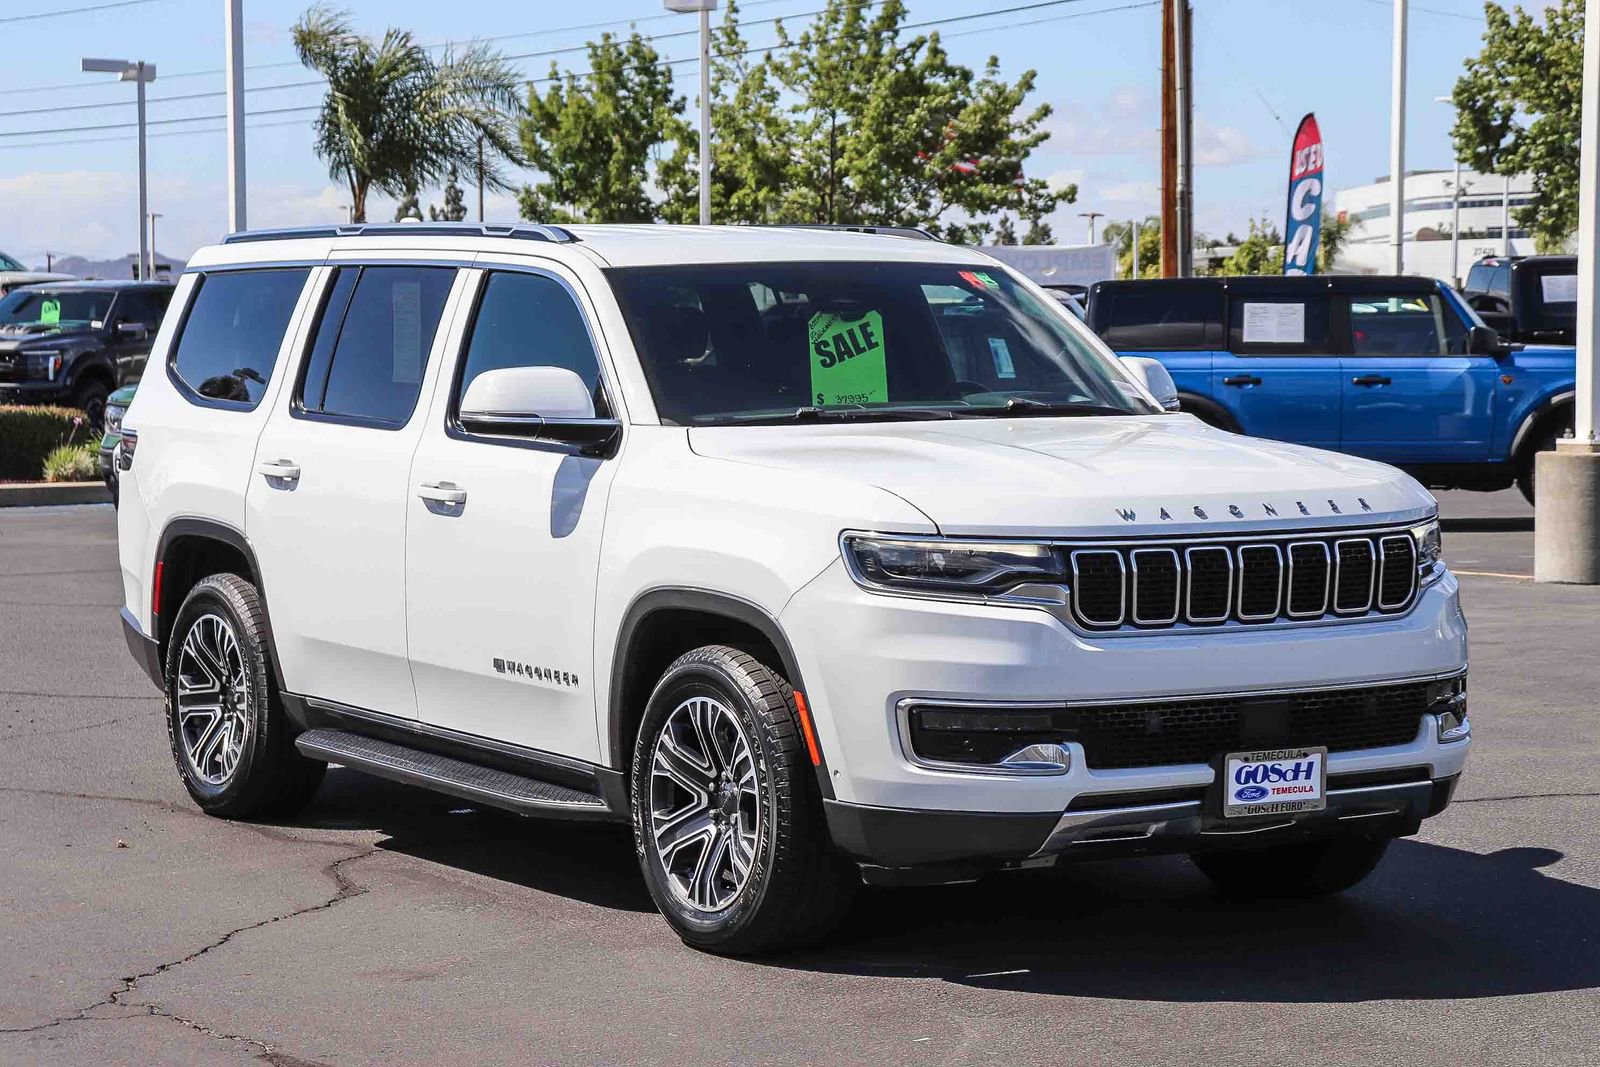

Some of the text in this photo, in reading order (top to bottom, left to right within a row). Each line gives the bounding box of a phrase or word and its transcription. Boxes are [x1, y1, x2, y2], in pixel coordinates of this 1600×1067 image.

[1295, 143, 1324, 175] USED
[1286, 178, 1321, 276] CA
[814, 321, 880, 368] SALE
[816, 392, 825, 405] $
[1115, 497, 1374, 522] WAGONEER
[1250, 749, 1303, 762] TEMECULA
[1271, 785, 1315, 795] TEMECULA
[1281, 801, 1303, 812] FORD
